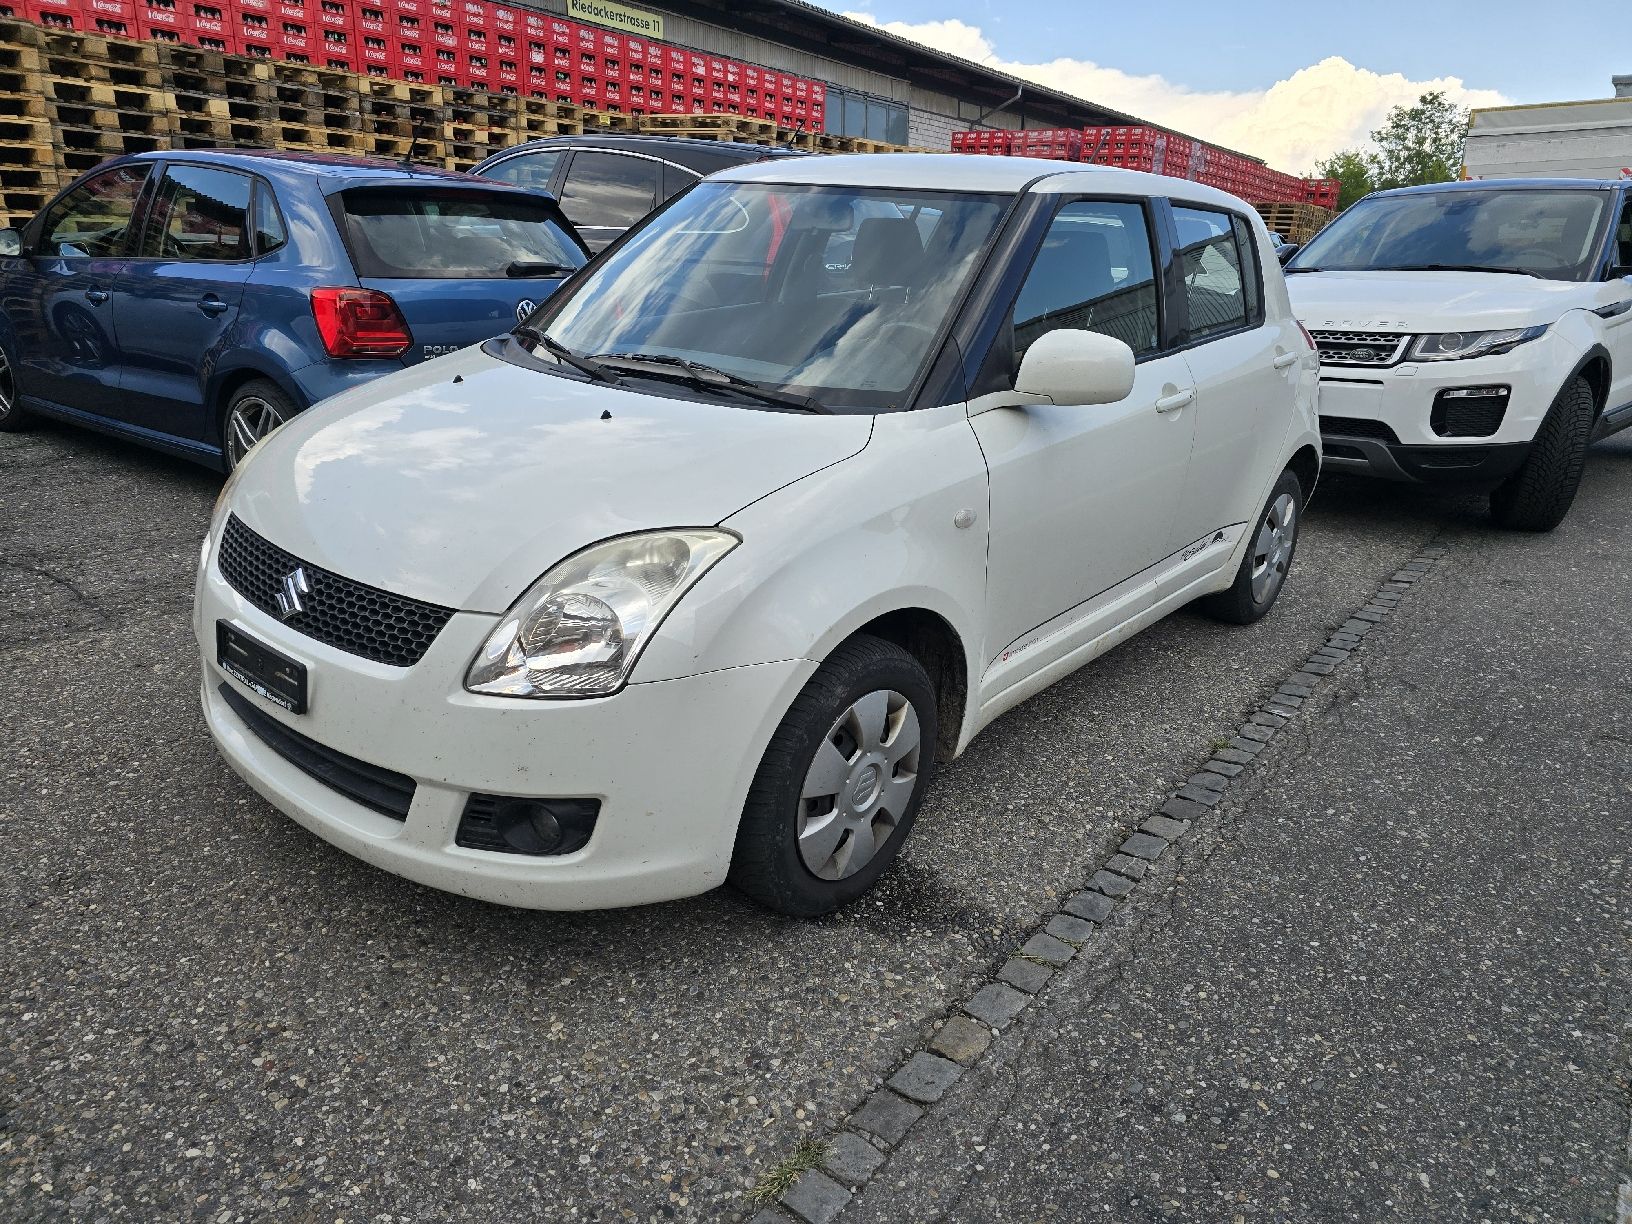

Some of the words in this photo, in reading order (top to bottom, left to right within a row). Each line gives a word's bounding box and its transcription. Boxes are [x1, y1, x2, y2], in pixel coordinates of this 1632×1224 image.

[571, 0, 650, 30] Riedackerstrasse
[652, 19, 660, 33] 11
[1322, 319, 1409, 330] ROVER
[423, 345, 458, 355] POLO
